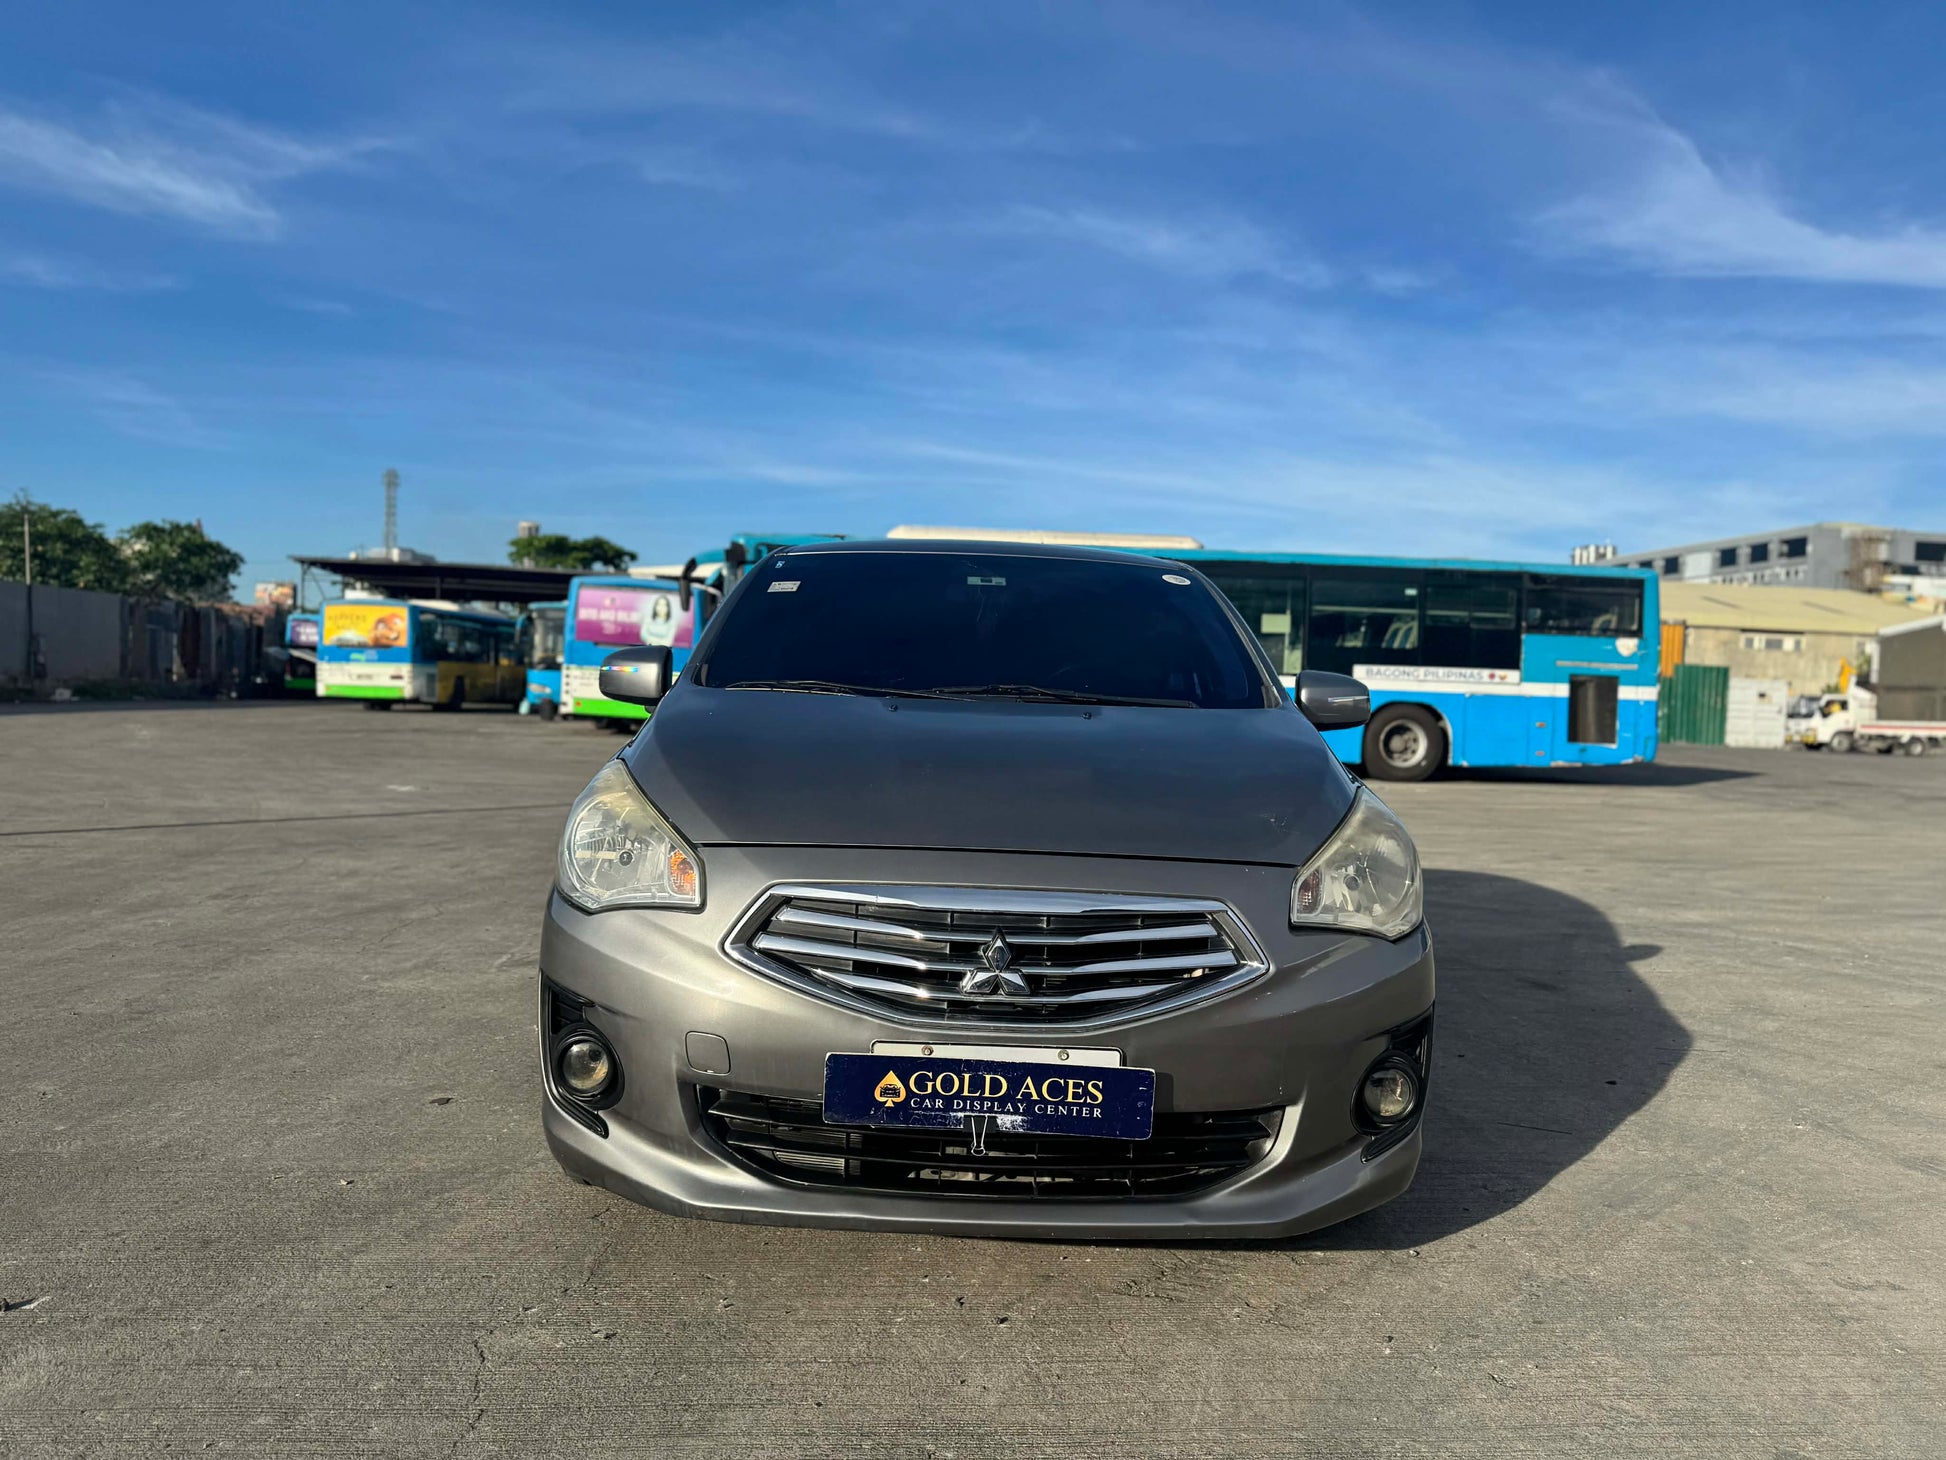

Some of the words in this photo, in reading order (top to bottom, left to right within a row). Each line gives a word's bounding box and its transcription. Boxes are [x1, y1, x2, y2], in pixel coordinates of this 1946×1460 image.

[1365, 667, 1421, 680] BAGONG
[1423, 669, 1483, 681] PILIPINAS
[909, 1071, 1008, 1098] GOLD
[1016, 1076, 1103, 1104] ACES
[910, 1098, 945, 1109] CAR
[953, 1100, 1027, 1113] DISPLAY
[1035, 1104, 1102, 1118] CENTER
